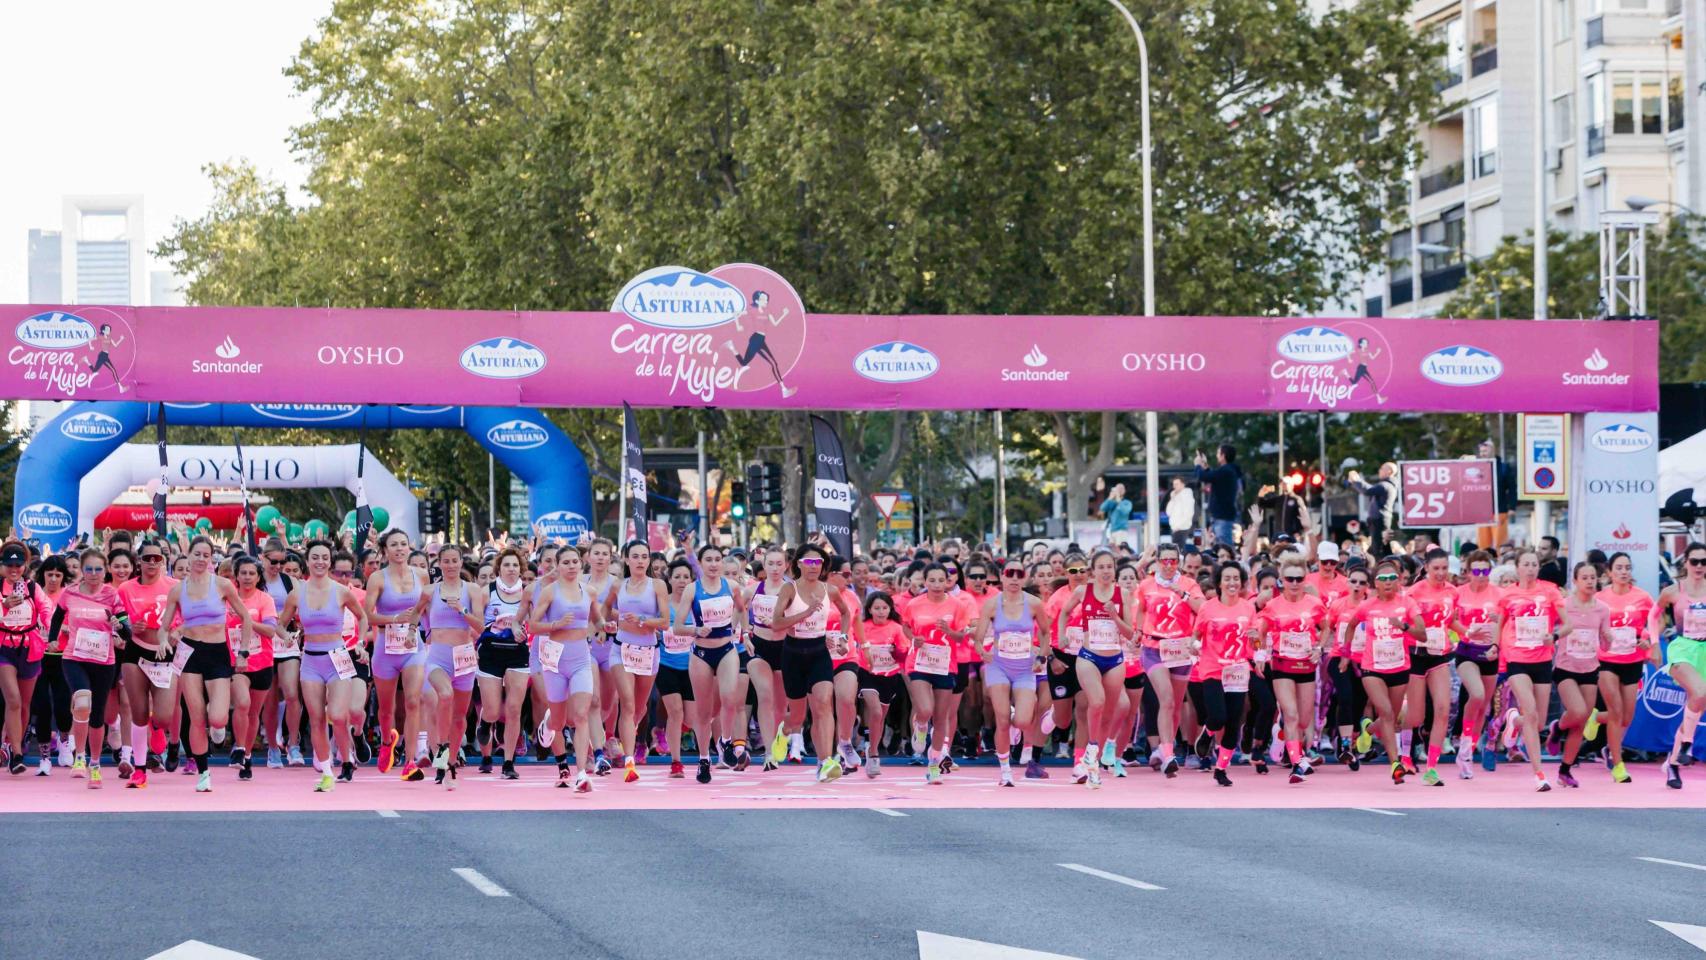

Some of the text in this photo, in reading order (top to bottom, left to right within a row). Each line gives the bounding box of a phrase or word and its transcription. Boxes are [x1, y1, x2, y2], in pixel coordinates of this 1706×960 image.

[632, 292, 736, 313] ASTURIANA
[22, 325, 90, 340] ASTURIANA
[611, 323, 713, 355] Carrera
[8, 347, 75, 366] Carrera
[318, 346, 404, 365] OYSHO
[1283, 340, 1349, 354] ASTURIANA
[192, 360, 263, 374] Santander
[467, 352, 540, 369] ASTURIANA
[860, 357, 933, 373] ASTURIANA
[1122, 353, 1206, 372] OYSHO
[1270, 360, 1334, 380] Carrera
[1426, 360, 1498, 376] ASTURIANA
[24, 365, 99, 396] de la Mujer
[636, 352, 751, 403] de la Mujer
[1001, 368, 1070, 382] Santander
[1562, 372, 1630, 386] Santander
[1286, 375, 1358, 408] de la Mujer
[181, 458, 299, 481] OYSHO
[1406, 467, 1451, 485] SUB
[1589, 480, 1655, 495] OYSHO
[1406, 491, 1456, 519] 25'
[1595, 541, 1649, 551] Santander
[1646, 679, 1687, 707] ASTURIAN
